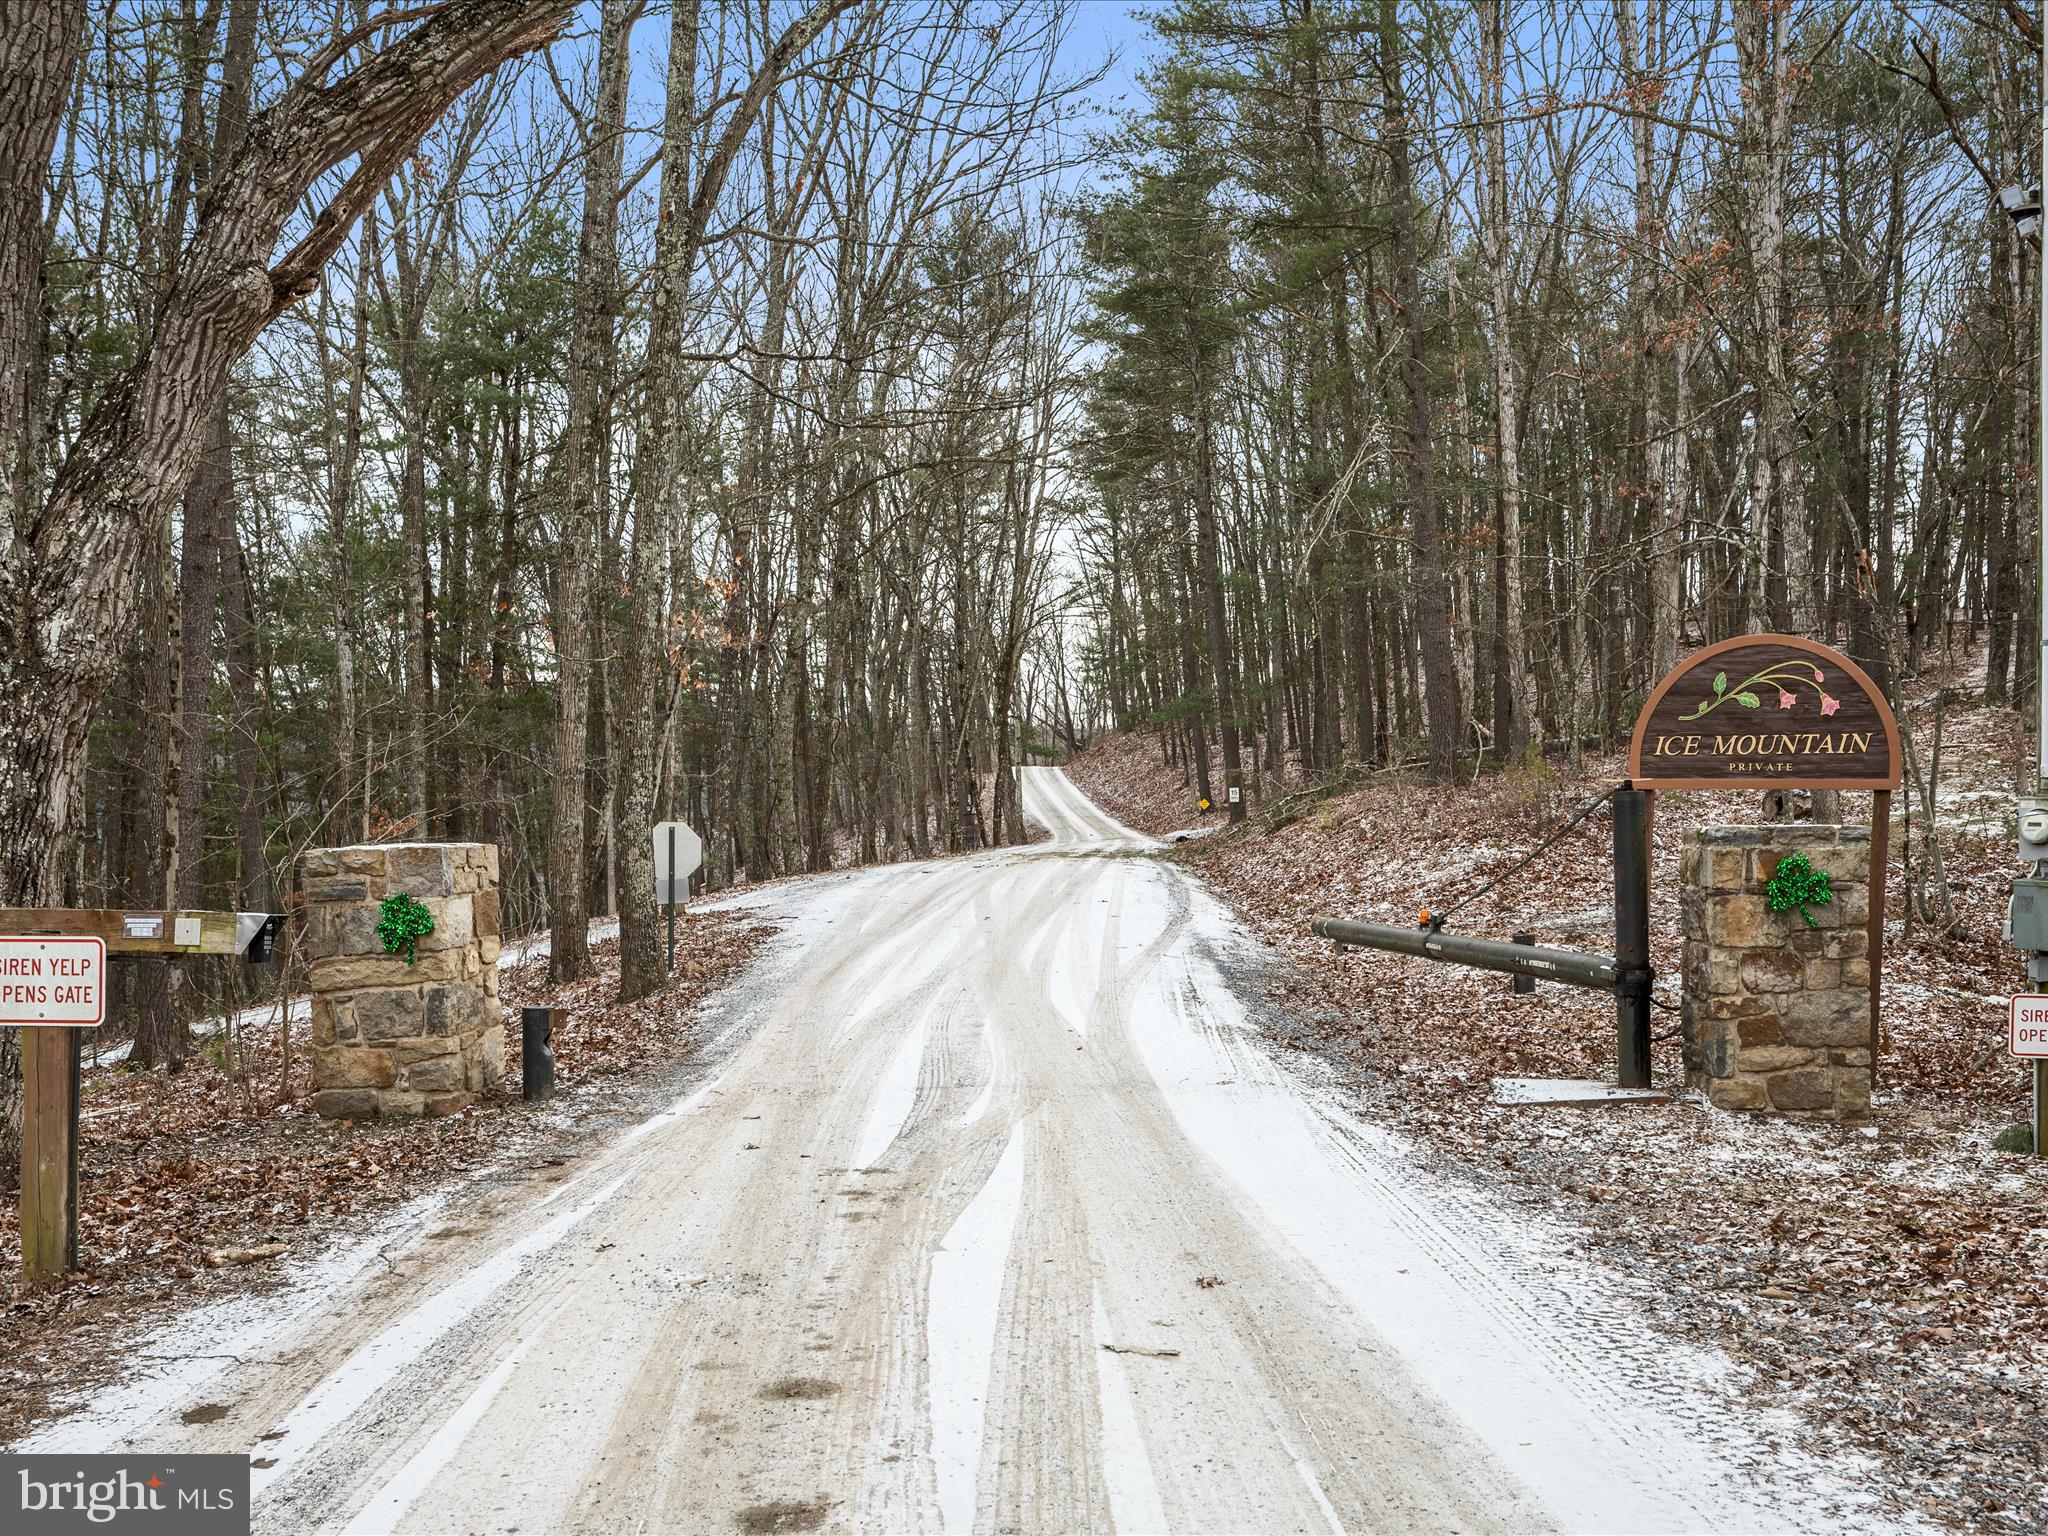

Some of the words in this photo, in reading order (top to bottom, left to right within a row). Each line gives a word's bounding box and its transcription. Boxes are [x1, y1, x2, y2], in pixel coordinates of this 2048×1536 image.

[1653, 735, 1702, 756] ICE
[1711, 732, 1873, 755] MOUNTAIN
[1729, 762, 1793, 772] PRIVATE
[0, 958, 41, 976] IREN
[49, 958, 91, 976] YELP
[3, 985, 47, 1004] PENS
[54, 985, 93, 1004] GATE
[2019, 1029, 2048, 1043] OPE
